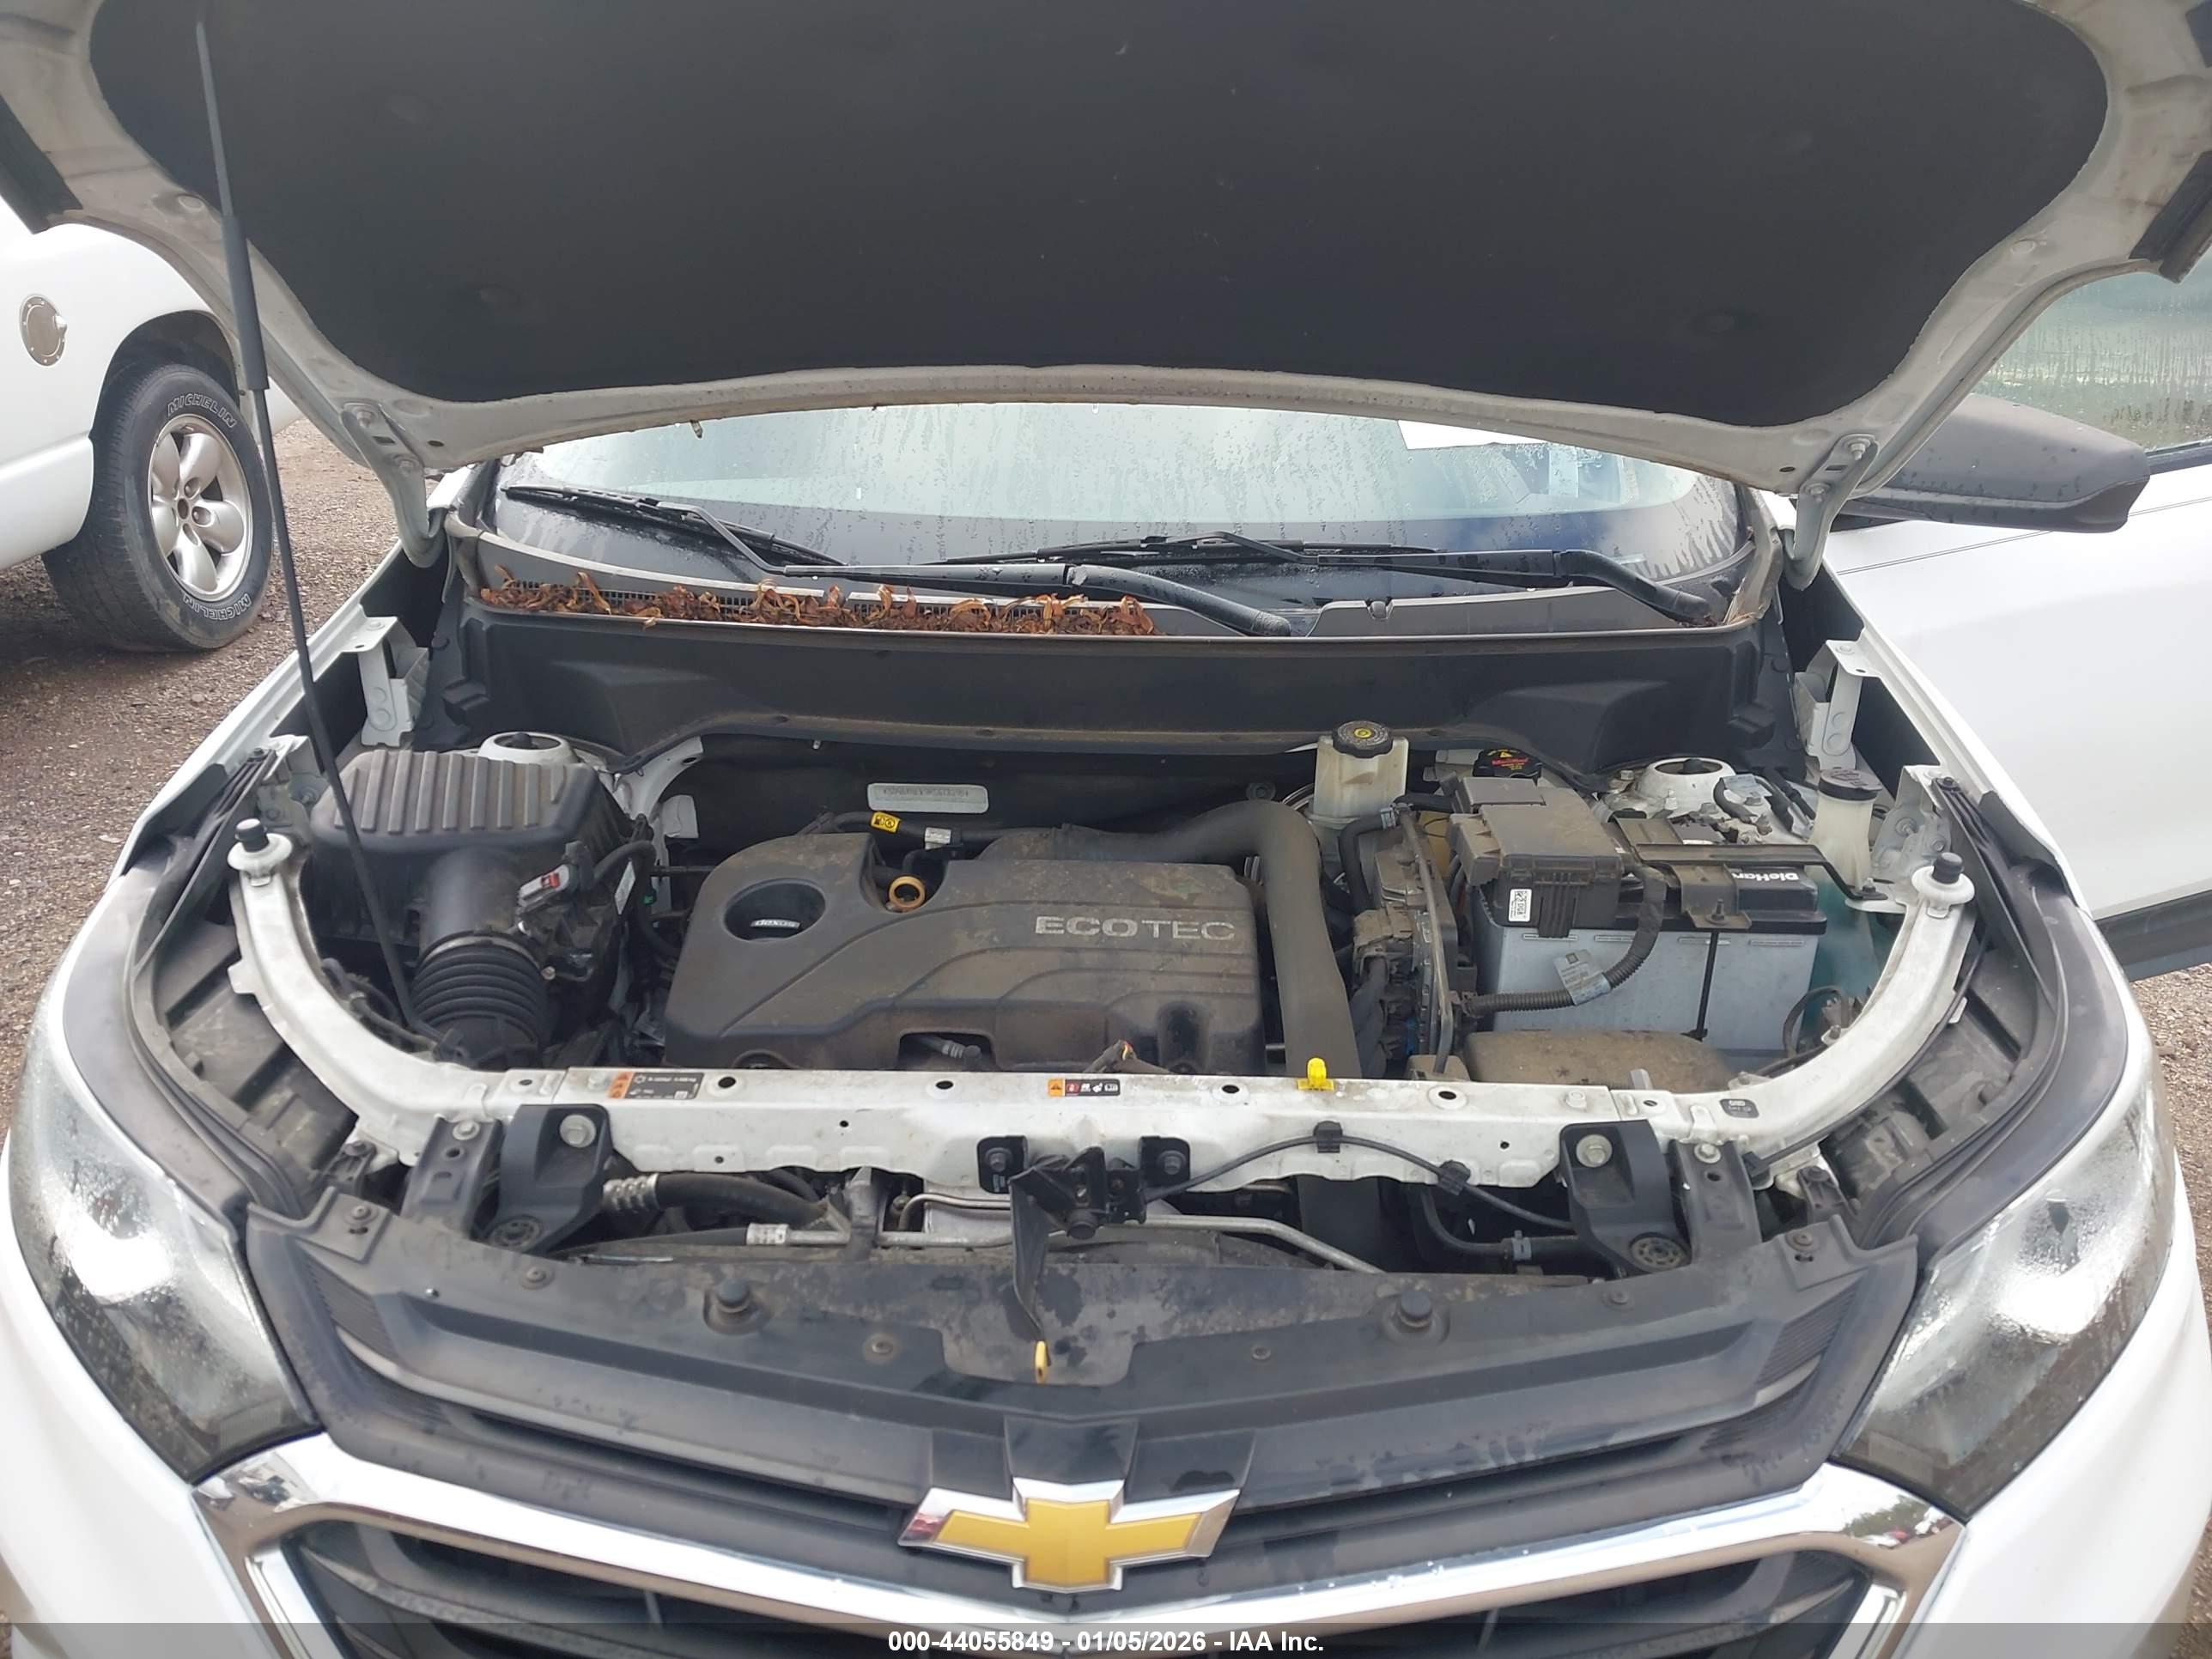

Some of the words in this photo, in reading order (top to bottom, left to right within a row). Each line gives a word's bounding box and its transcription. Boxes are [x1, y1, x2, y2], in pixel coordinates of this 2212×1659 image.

[167, 392, 237, 428] MICHELIN
[183, 593, 251, 621] MICHELIN
[1036, 915, 1235, 940] ECOTEC
